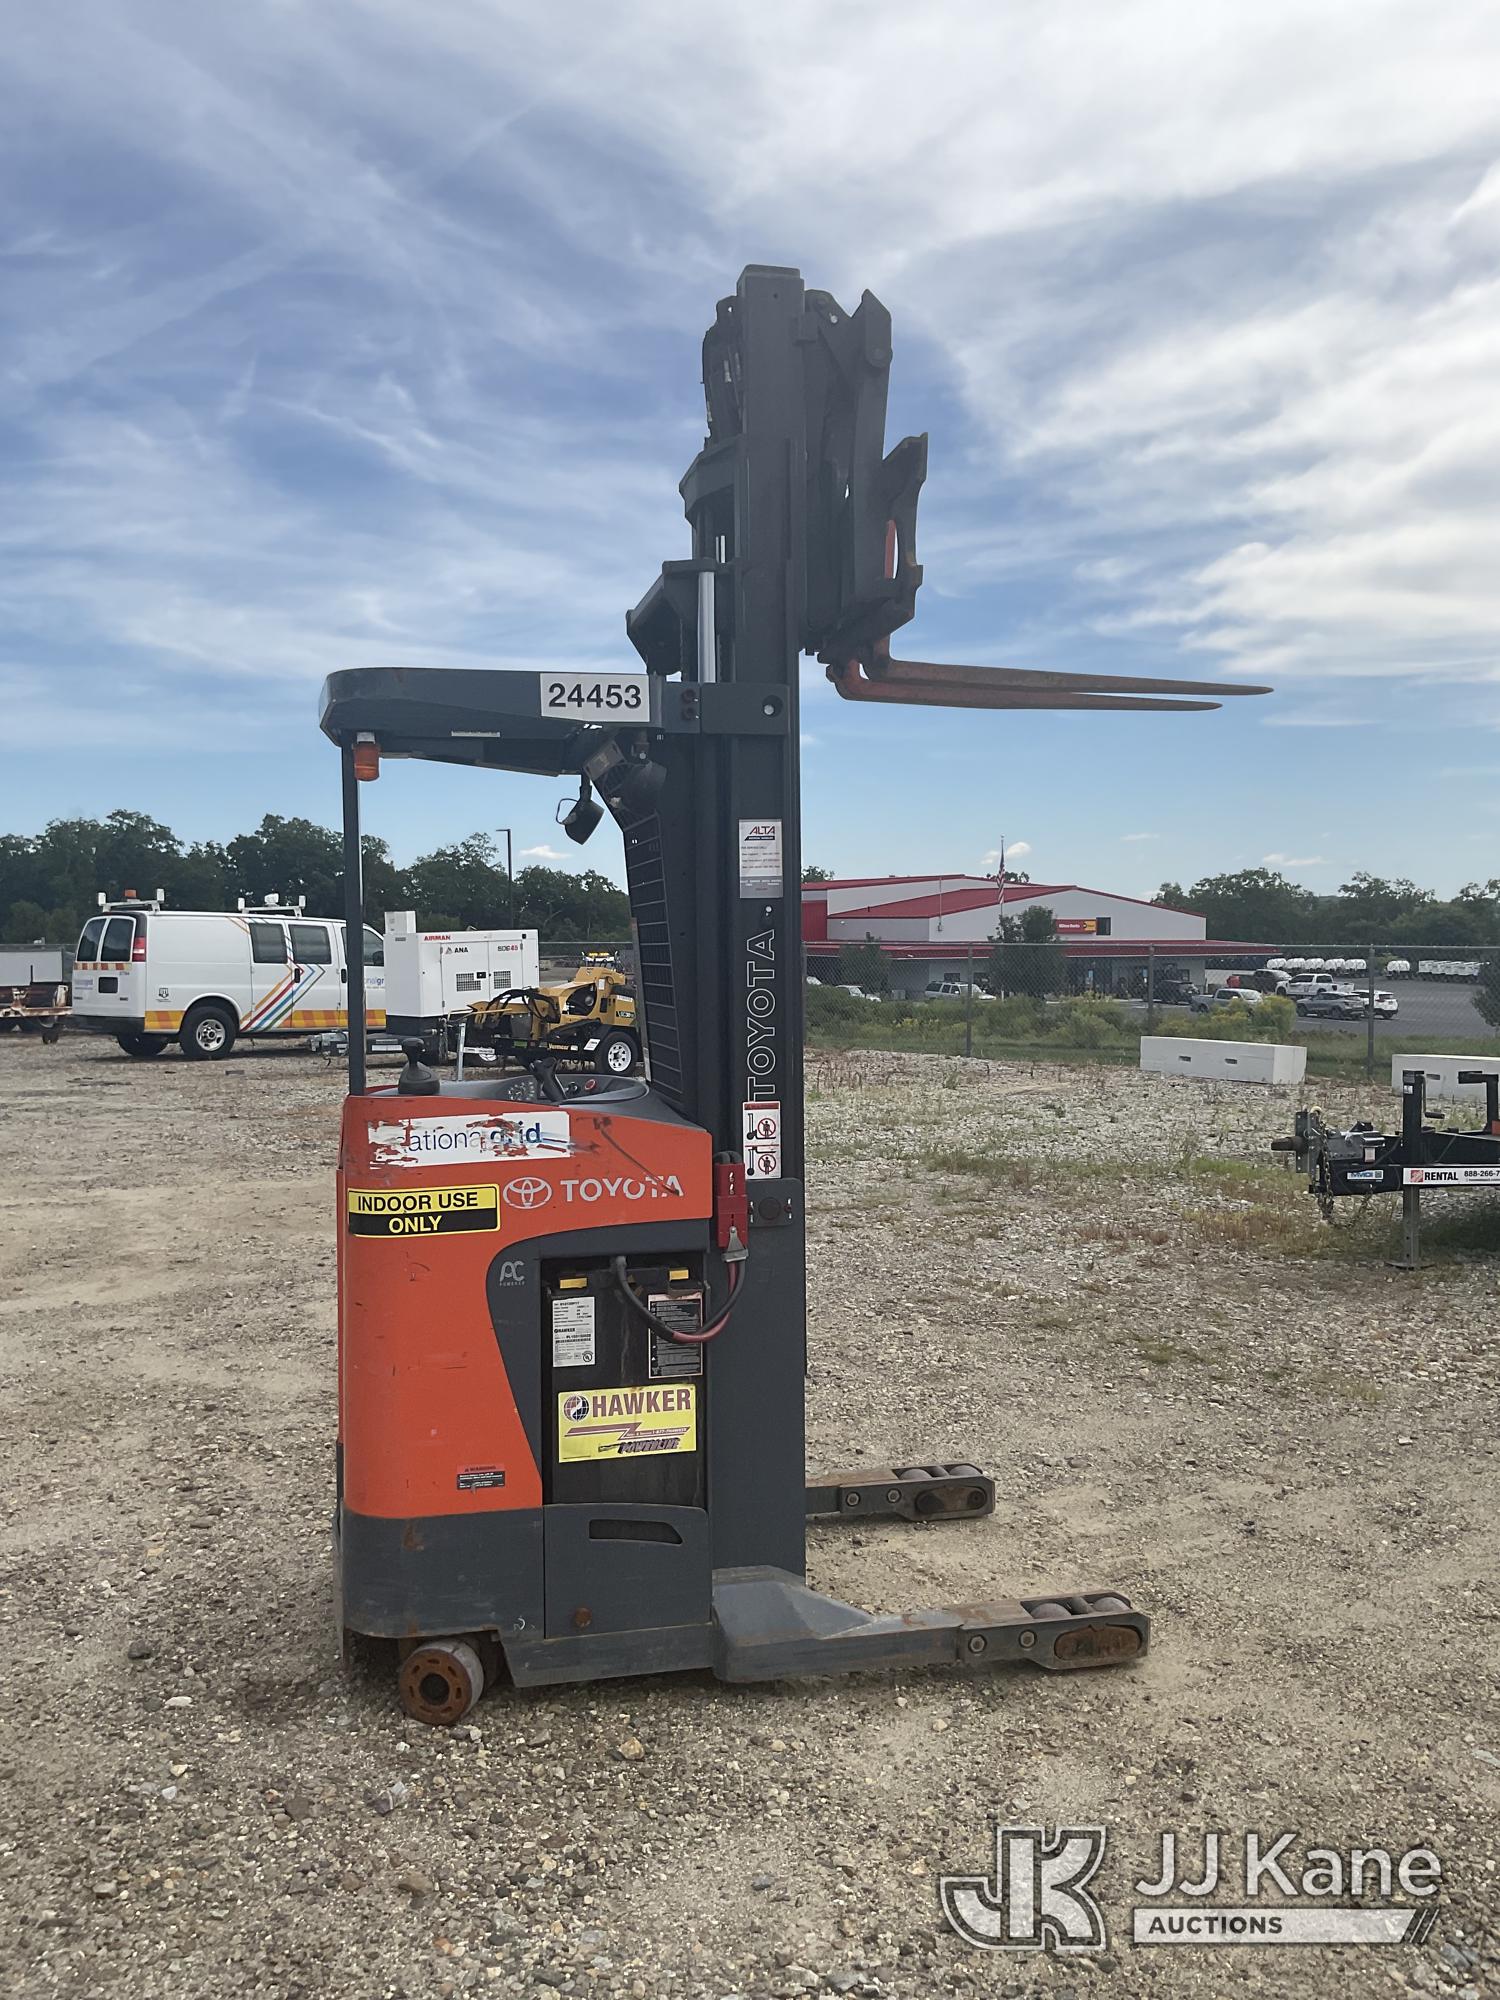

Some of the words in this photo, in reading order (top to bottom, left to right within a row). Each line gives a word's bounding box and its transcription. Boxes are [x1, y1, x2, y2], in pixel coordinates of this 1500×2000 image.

[548, 682, 642, 709] 24453
[749, 825, 776, 835] ALTA
[423, 934, 451, 942] AIRMAN
[454, 946, 469, 954] ANA
[746, 928, 776, 1102] TOYOTA
[396, 1126, 484, 1154] ationa
[1424, 1171, 1459, 1181] RENTAL
[560, 1175, 684, 1202] TOYOTA
[357, 1194, 432, 1212] INDOOR
[438, 1191, 479, 1209] USE
[388, 1215, 443, 1234] ONLY
[592, 1388, 692, 1418] HAWKER
